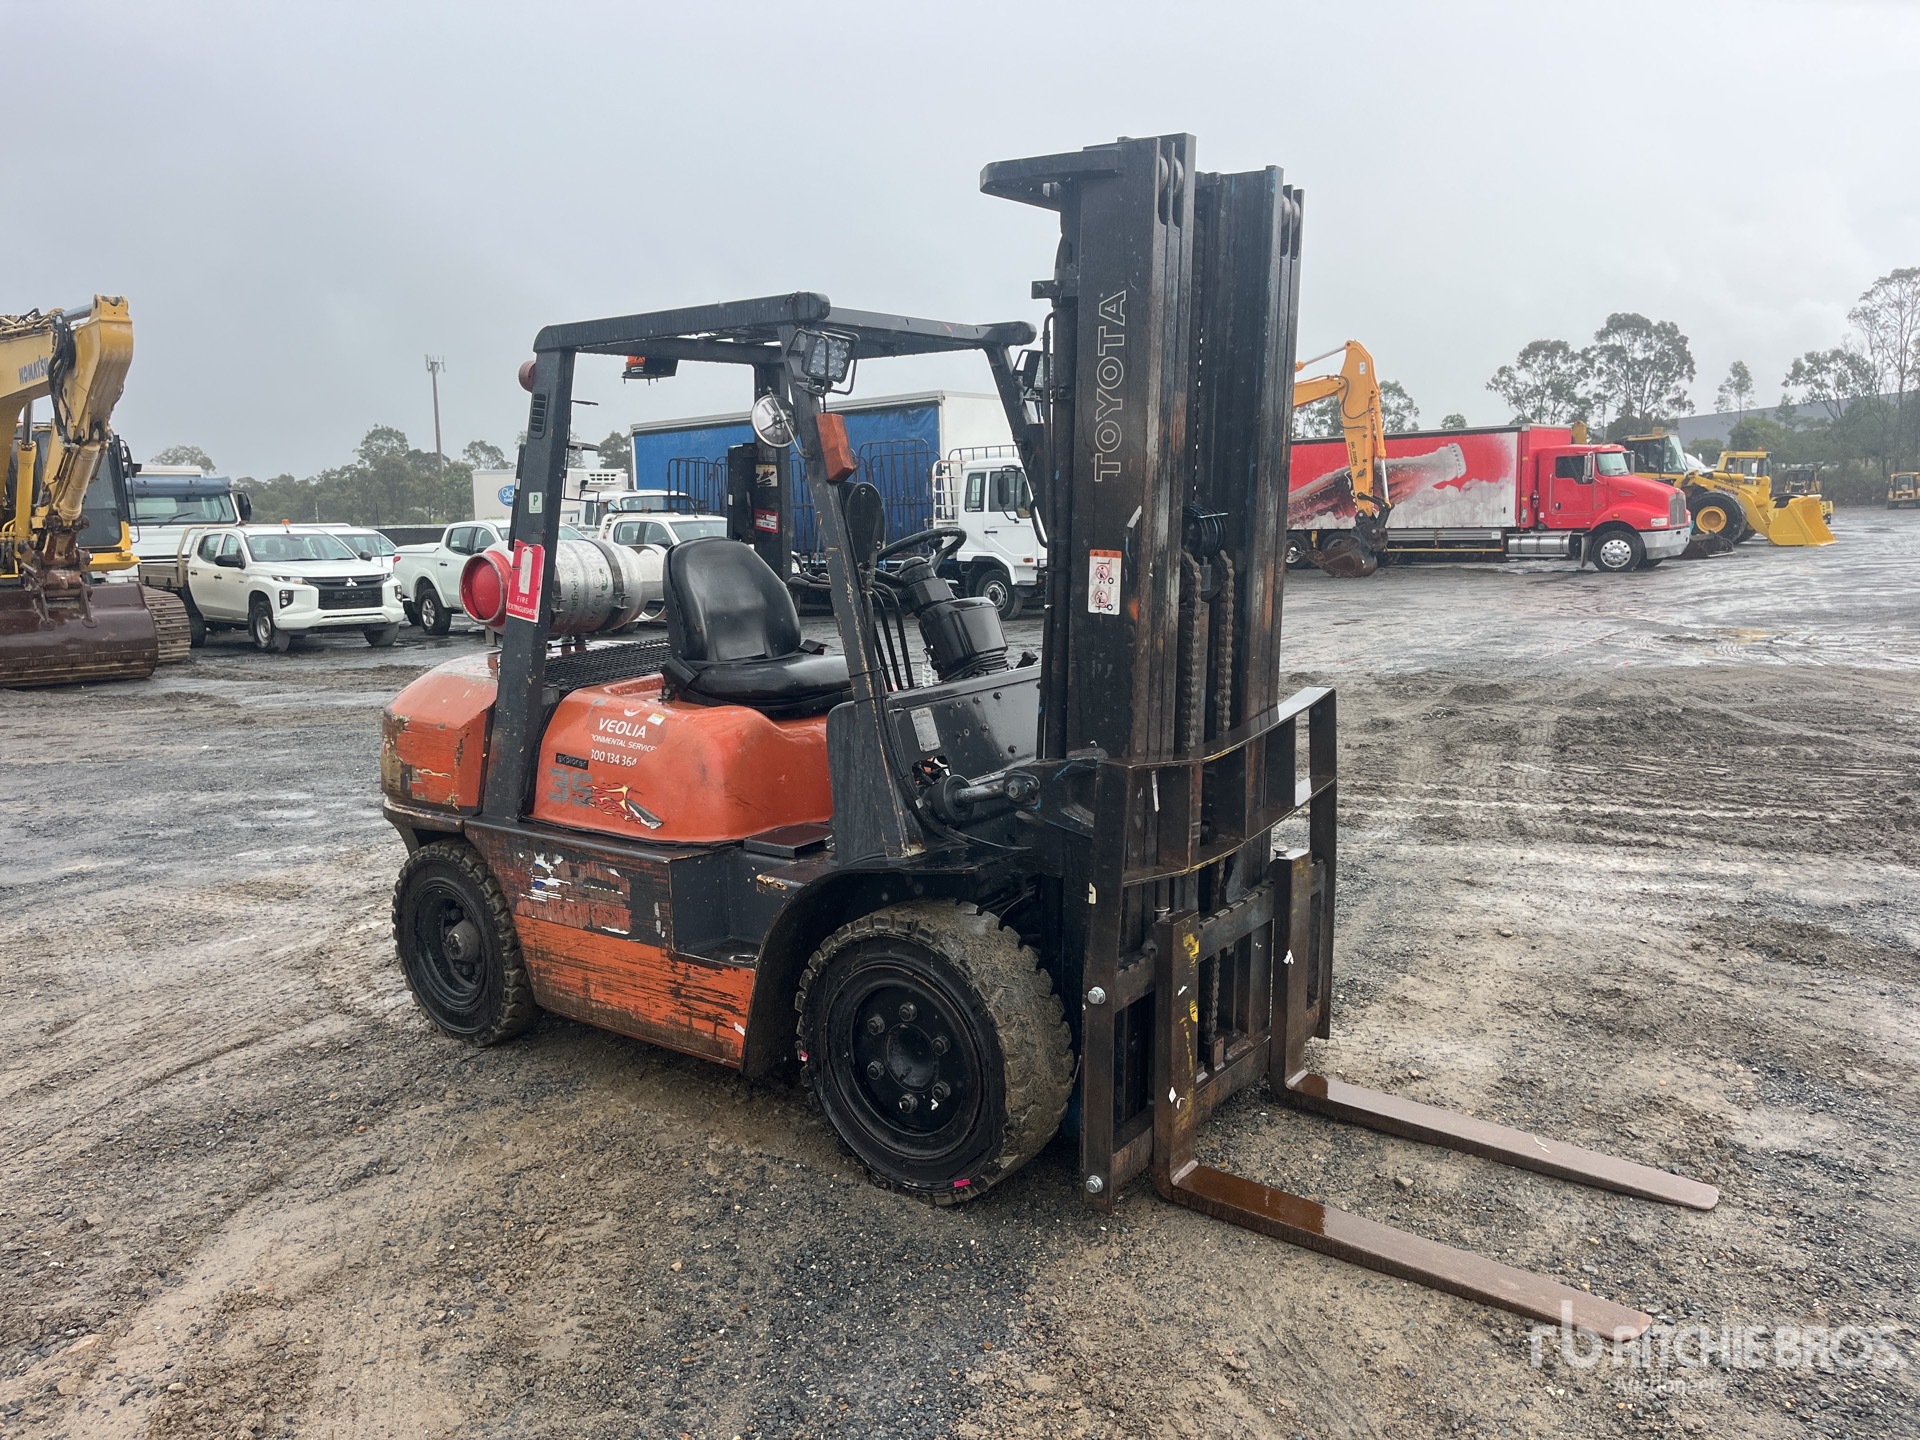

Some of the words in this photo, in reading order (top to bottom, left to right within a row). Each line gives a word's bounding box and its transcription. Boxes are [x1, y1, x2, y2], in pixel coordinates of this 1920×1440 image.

[1094, 290, 1127, 482] TOYOTA
[533, 494, 539, 506] P
[516, 595, 529, 605] FIRE
[507, 602, 537, 616] EXTINGUISHER
[598, 717, 647, 739] VEOLIA
[557, 754, 587, 768] explorer
[607, 752, 620, 765] 134
[548, 767, 593, 808] 35
